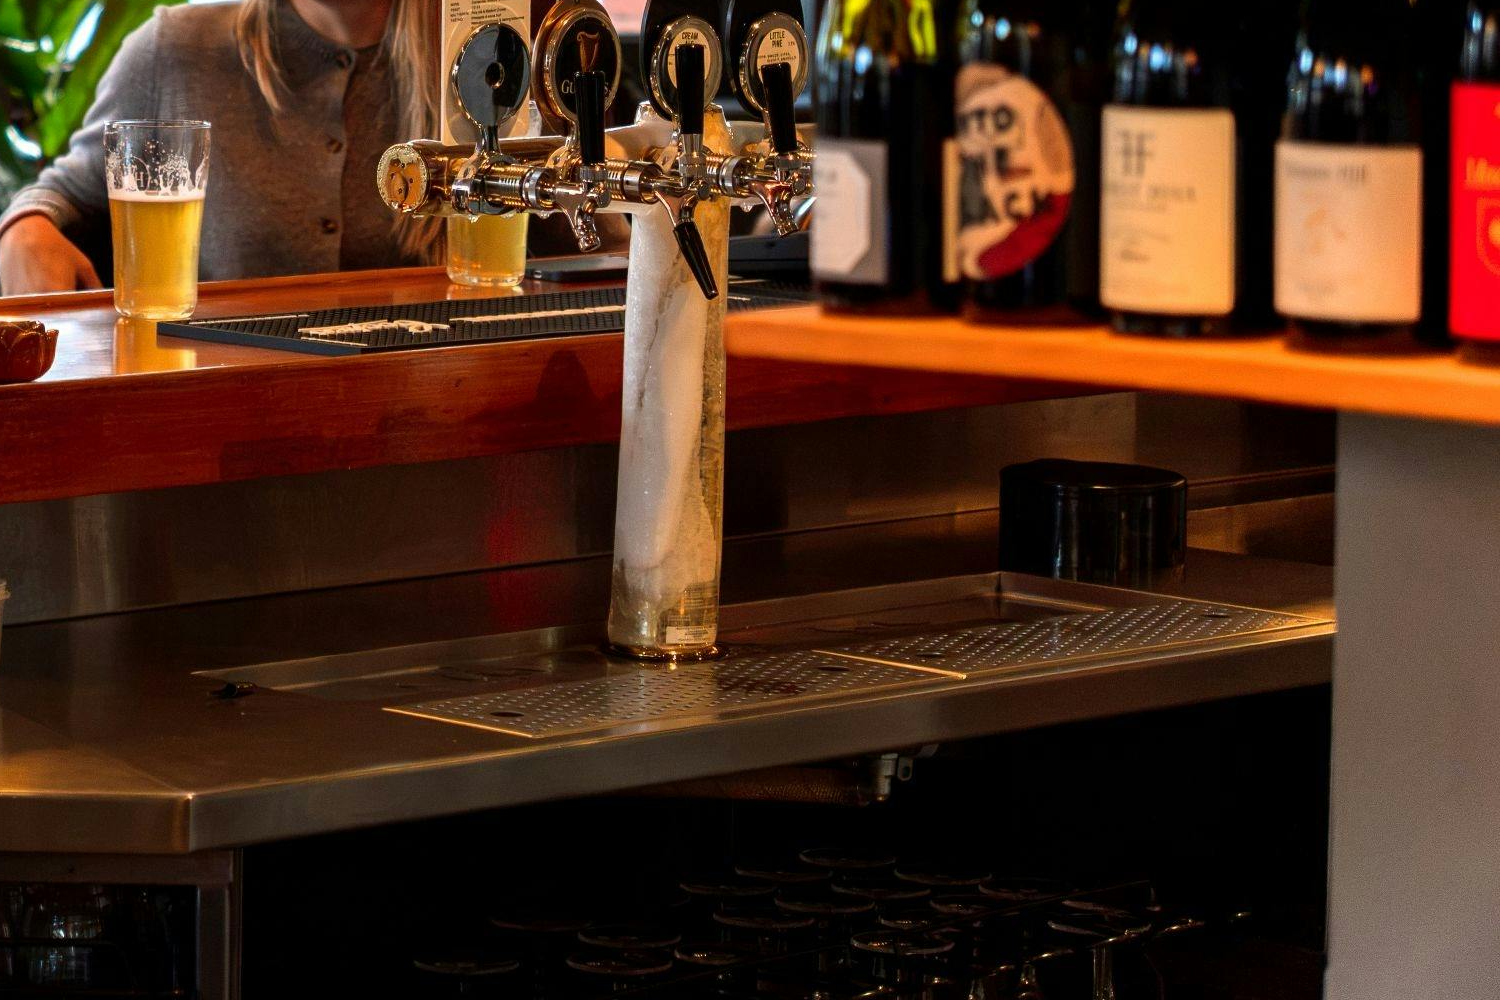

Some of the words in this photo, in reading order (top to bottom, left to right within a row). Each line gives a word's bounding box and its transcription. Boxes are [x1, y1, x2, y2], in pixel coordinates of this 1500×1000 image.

[681, 31, 699, 40] CREAM
[769, 30, 785, 40] LITTLE
[772, 40, 783, 48] PINE
